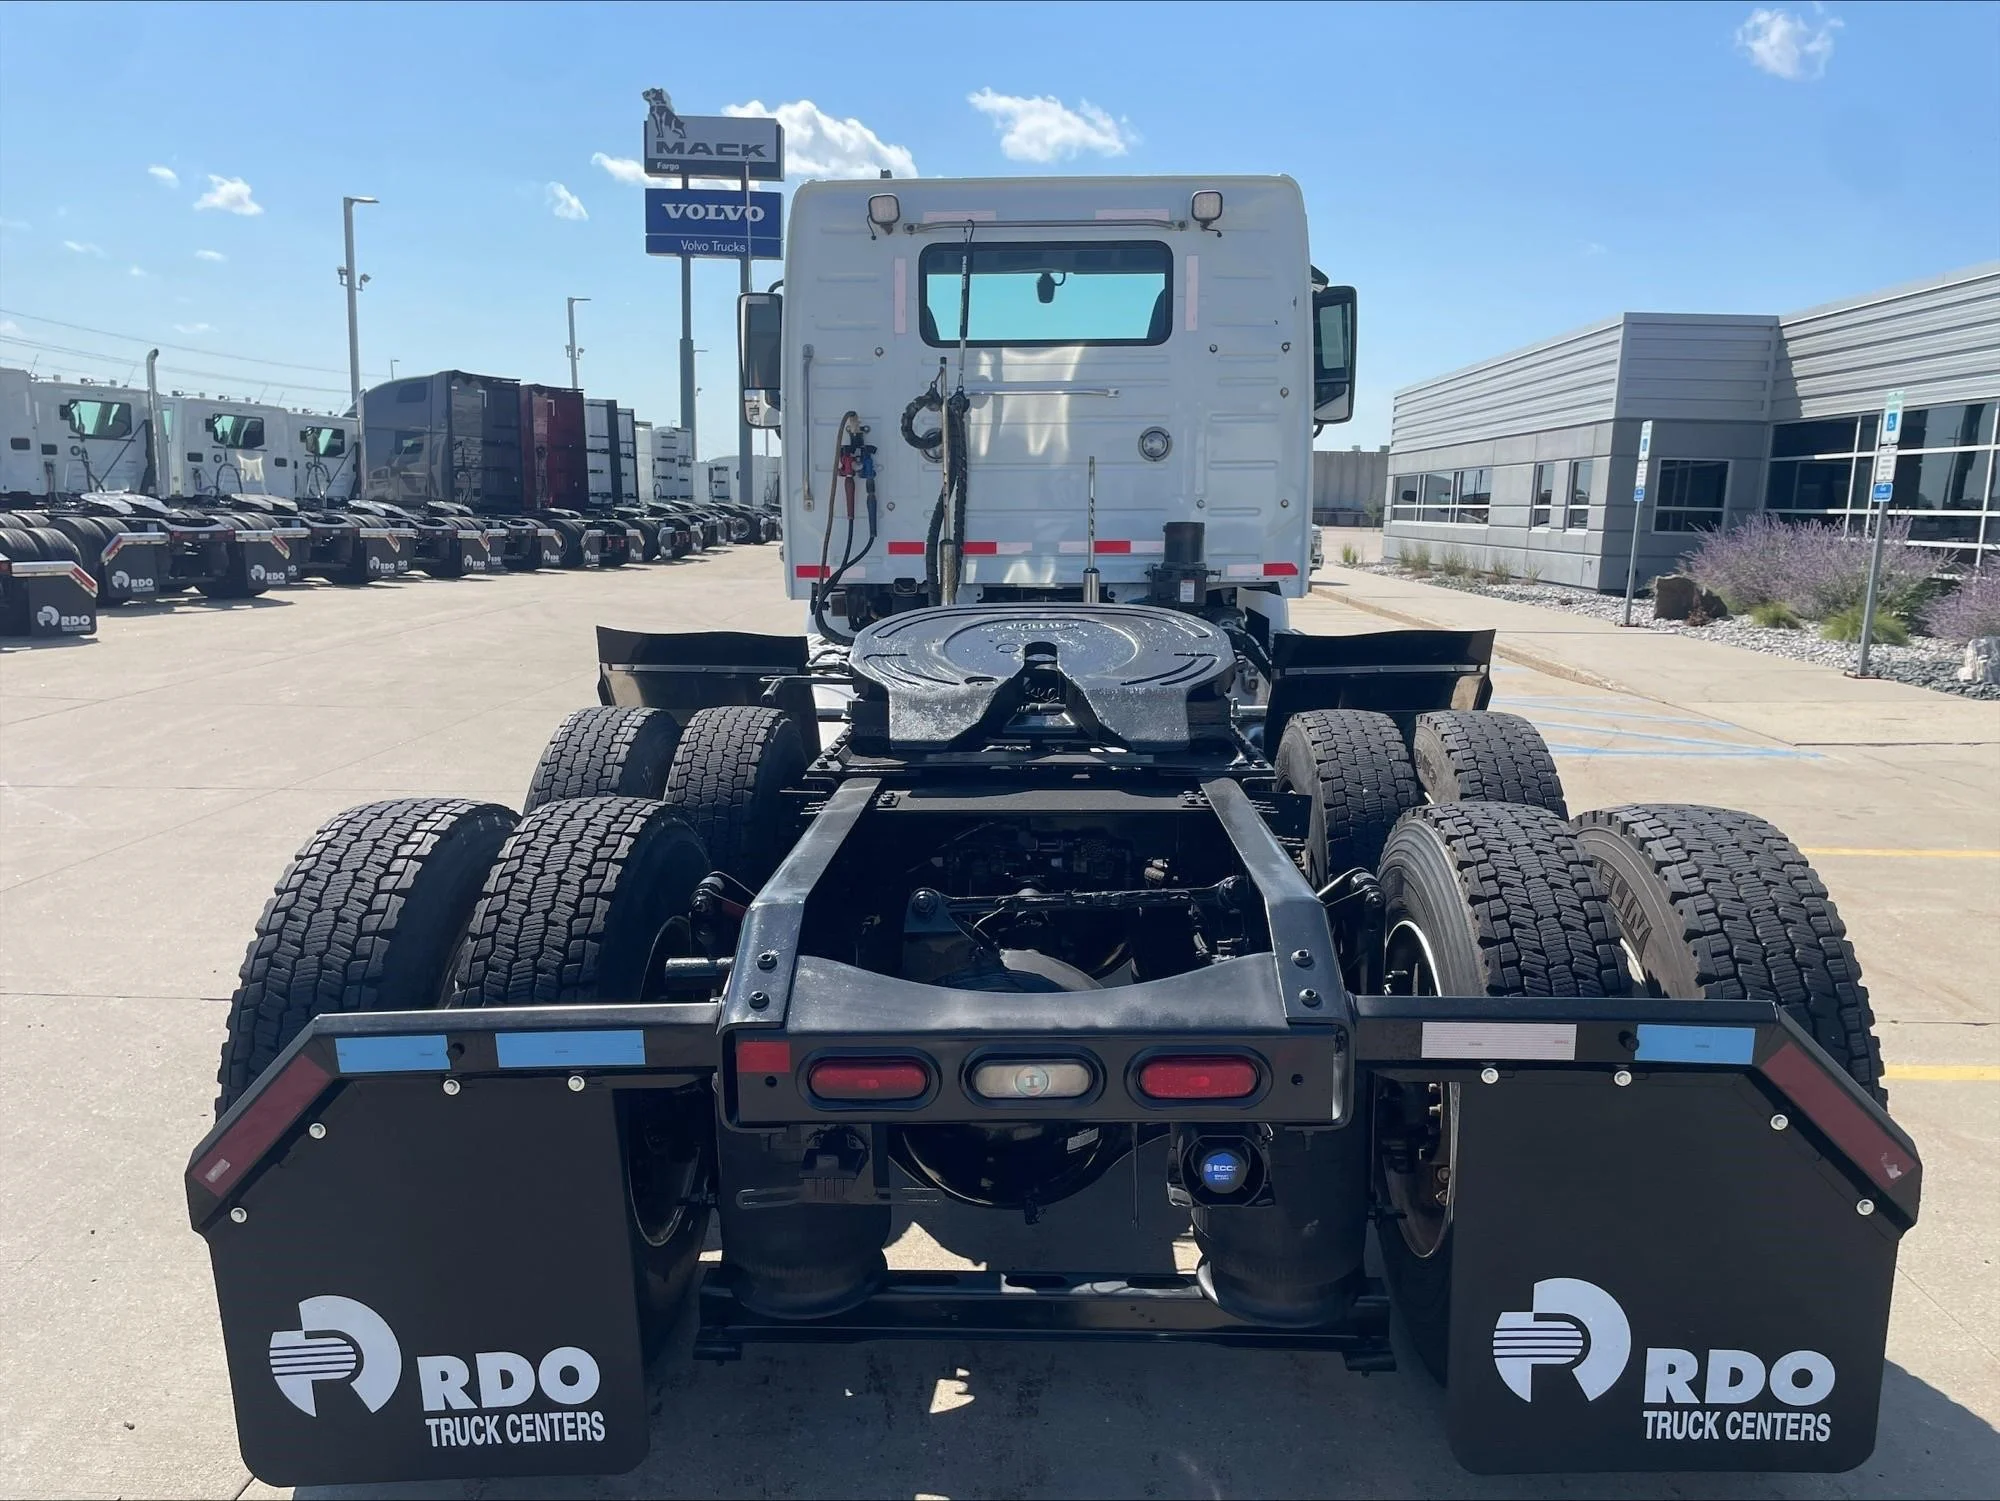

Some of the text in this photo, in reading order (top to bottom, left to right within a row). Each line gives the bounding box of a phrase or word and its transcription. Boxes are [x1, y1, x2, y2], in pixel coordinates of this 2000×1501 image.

[656, 141, 766, 157] MACK
[656, 162, 680, 171] Fargo
[662, 203, 765, 222] VOLVO
[681, 239, 746, 252] Volvo Trucks
[131, 578, 154, 587] RDO
[266, 572, 285, 580] RDO
[61, 615, 90, 625] RDO
[416, 1346, 601, 1412] RDO
[1644, 1347, 1836, 1406] RDO
[425, 1411, 606, 1448] TRUCK CENTERS
[1643, 1410, 1832, 1442] TRUCK CENTERS
